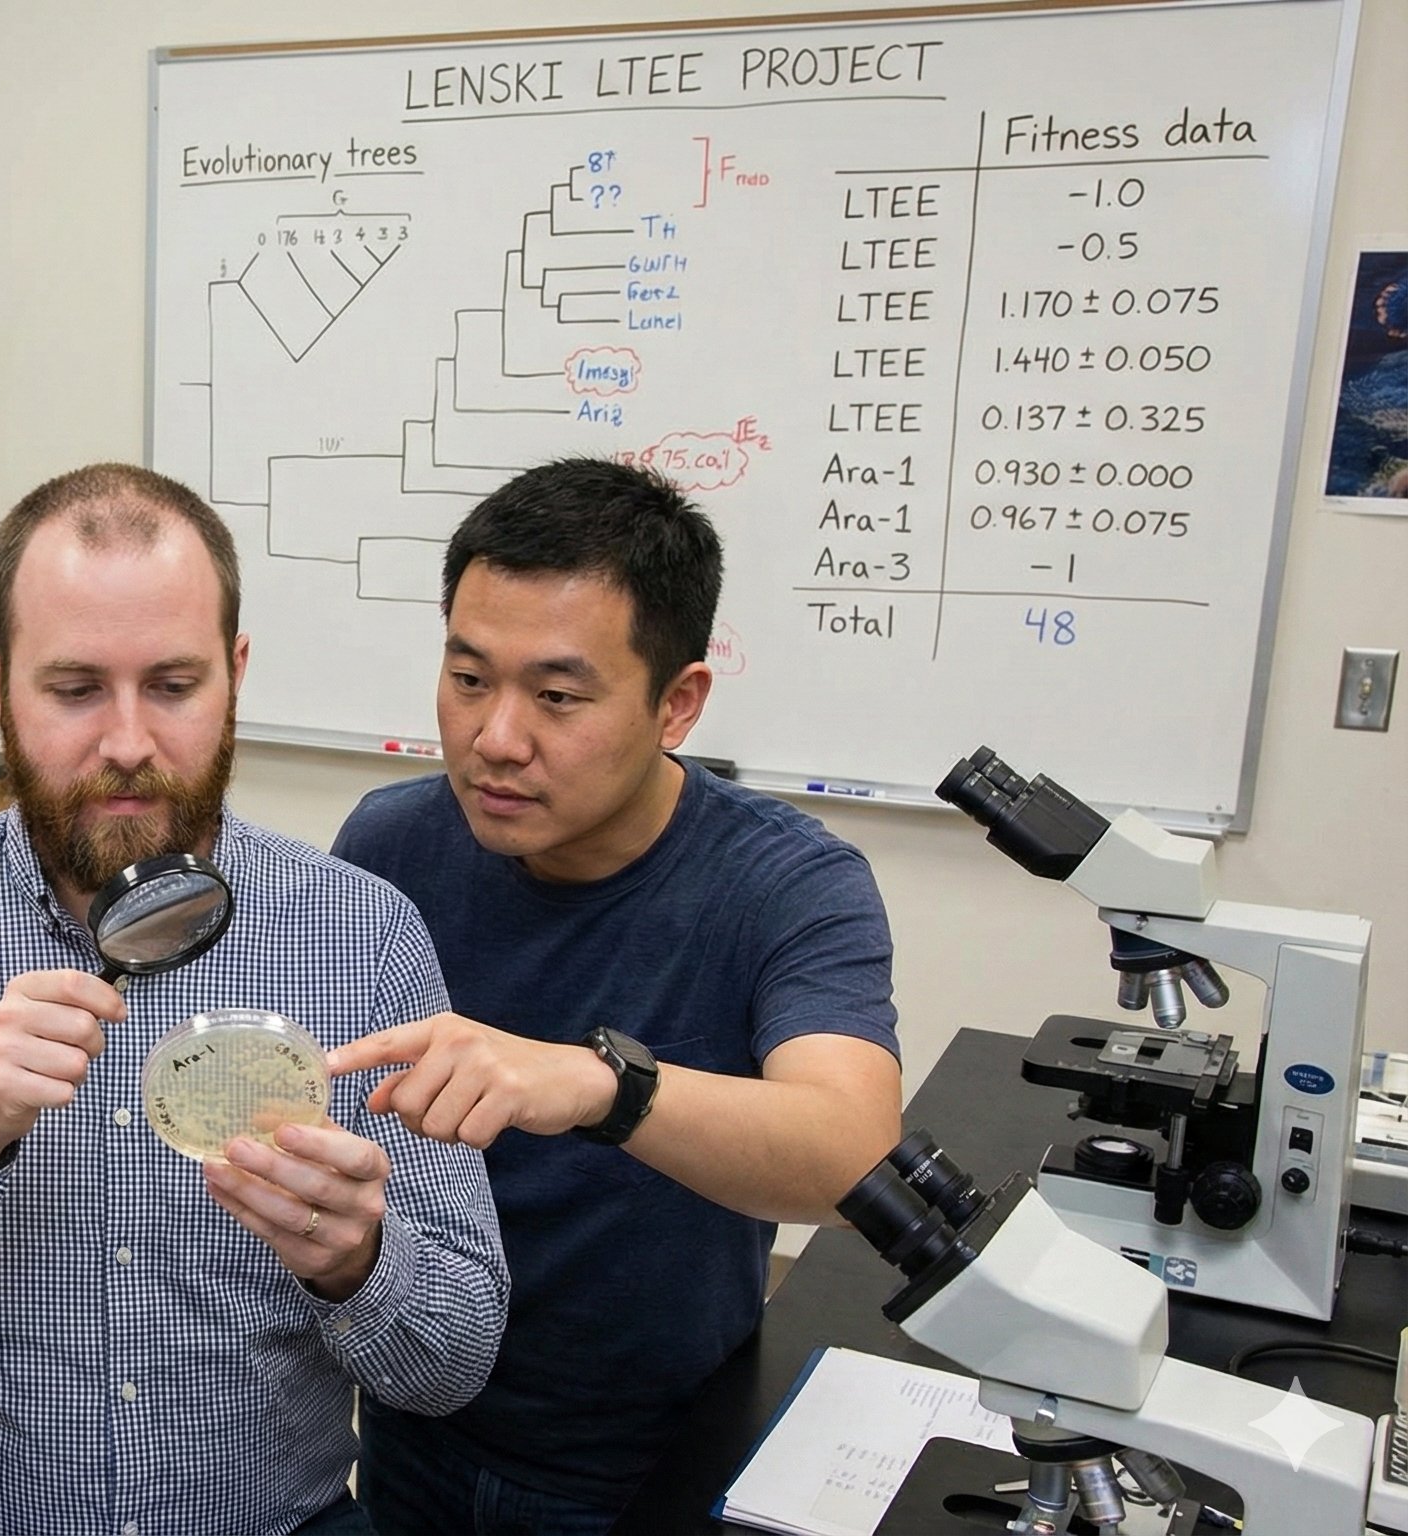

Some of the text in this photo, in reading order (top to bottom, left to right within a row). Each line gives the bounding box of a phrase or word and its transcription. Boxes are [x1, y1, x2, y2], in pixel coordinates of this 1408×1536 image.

[405, 40, 944, 110] LENSKI LTEE PROJECT
[1004, 105, 1258, 156] Fitness data
[182, 136, 418, 185] Evolutionary trees
[591, 184, 621, 209] ??
[844, 177, 1145, 220] LTEE -1.0
[840, 231, 1139, 271] LTEE -0.5
[837, 286, 1220, 323] LTEE 1.170 ± 0.075
[833, 345, 1212, 379] LTEE 1.440 ± 0.050
[828, 402, 1207, 434] LTEE 0.137 ± 0.325
[821, 452, 1194, 490] Ara-1 0.930 ± 0.000
[818, 498, 1191, 538] Ara-1 0.967 ± 0.075
[813, 546, 911, 582] Ara-3
[806, 602, 1077, 647] Total 48
[172, 1044, 216, 1073] Ara-1
